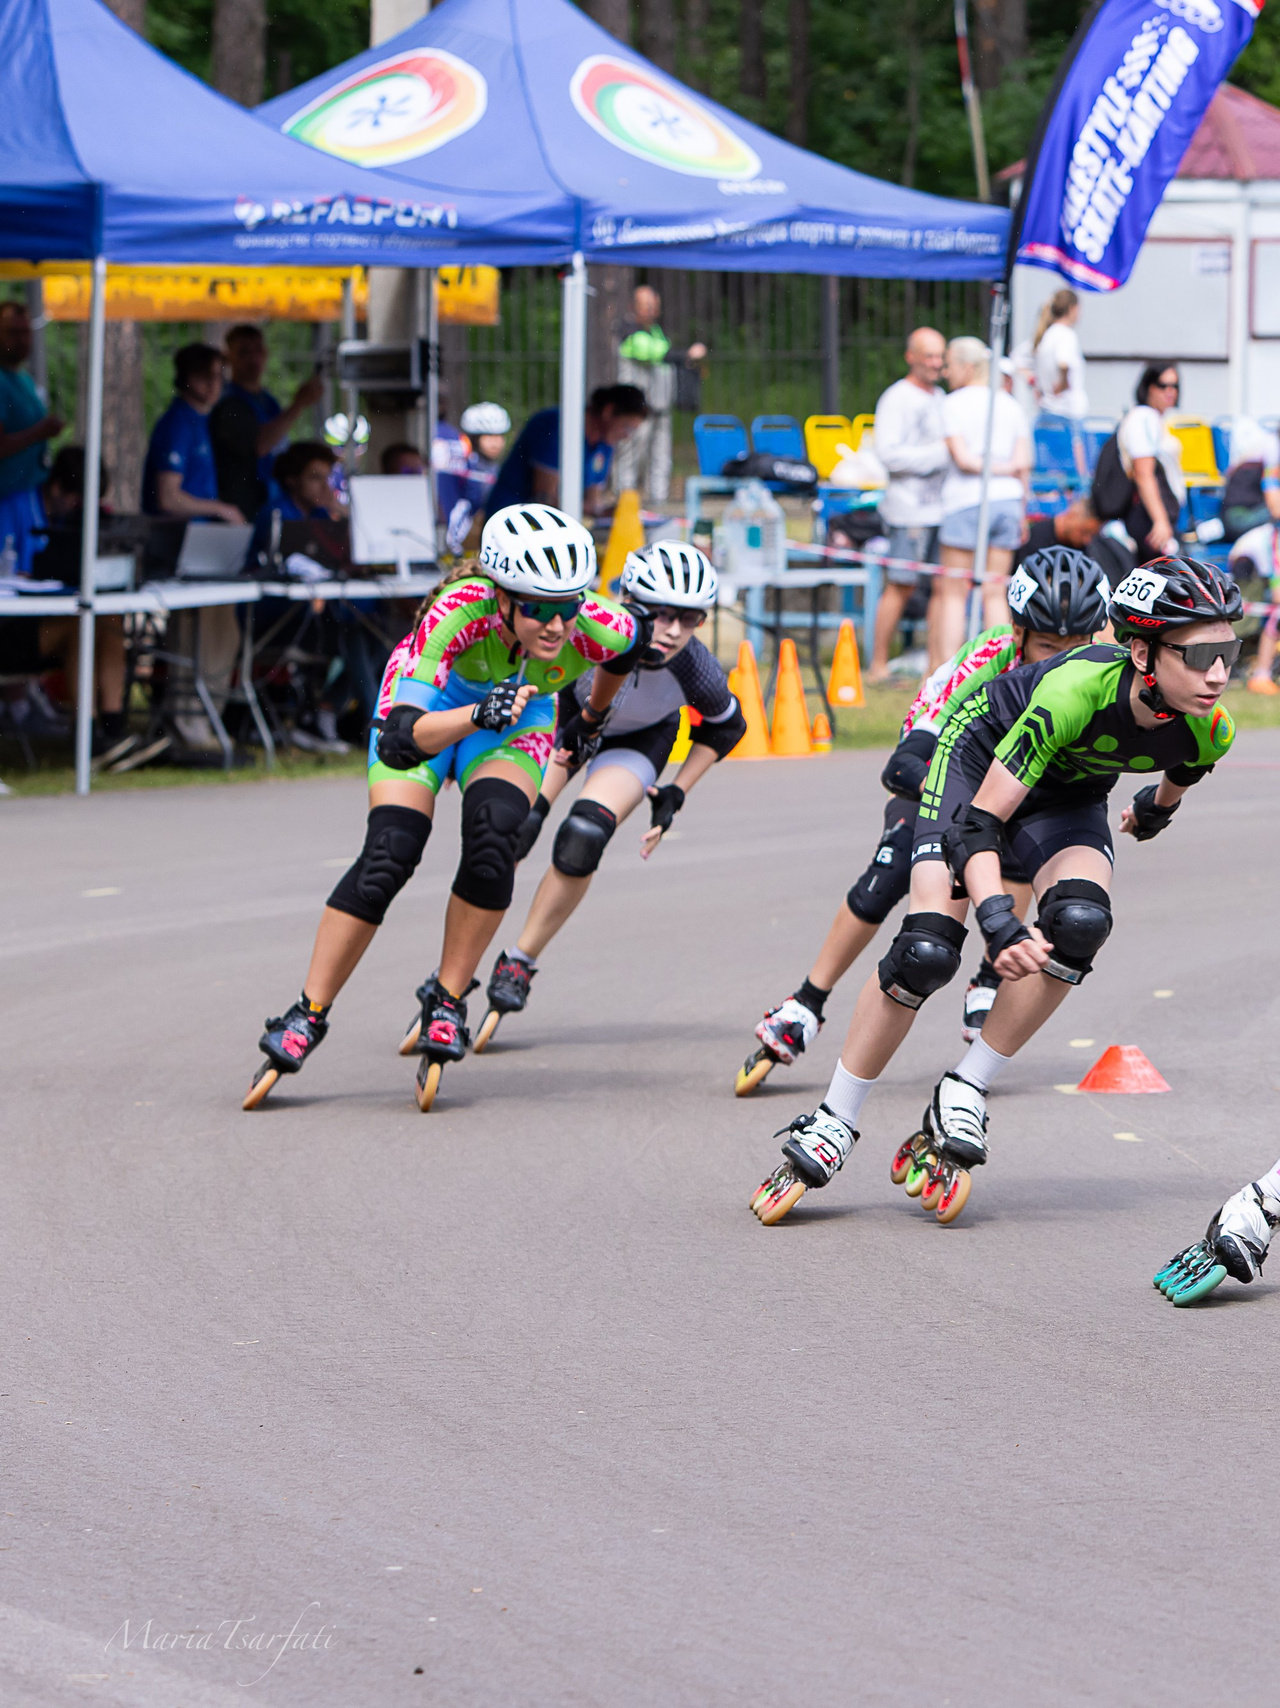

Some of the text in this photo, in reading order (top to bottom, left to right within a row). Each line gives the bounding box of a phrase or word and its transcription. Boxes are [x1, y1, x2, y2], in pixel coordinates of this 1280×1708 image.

[482, 545, 510, 574] 514
[1009, 579, 1027, 602] 58
[1119, 576, 1156, 602] 556
[1126, 615, 1167, 627] RUDY
